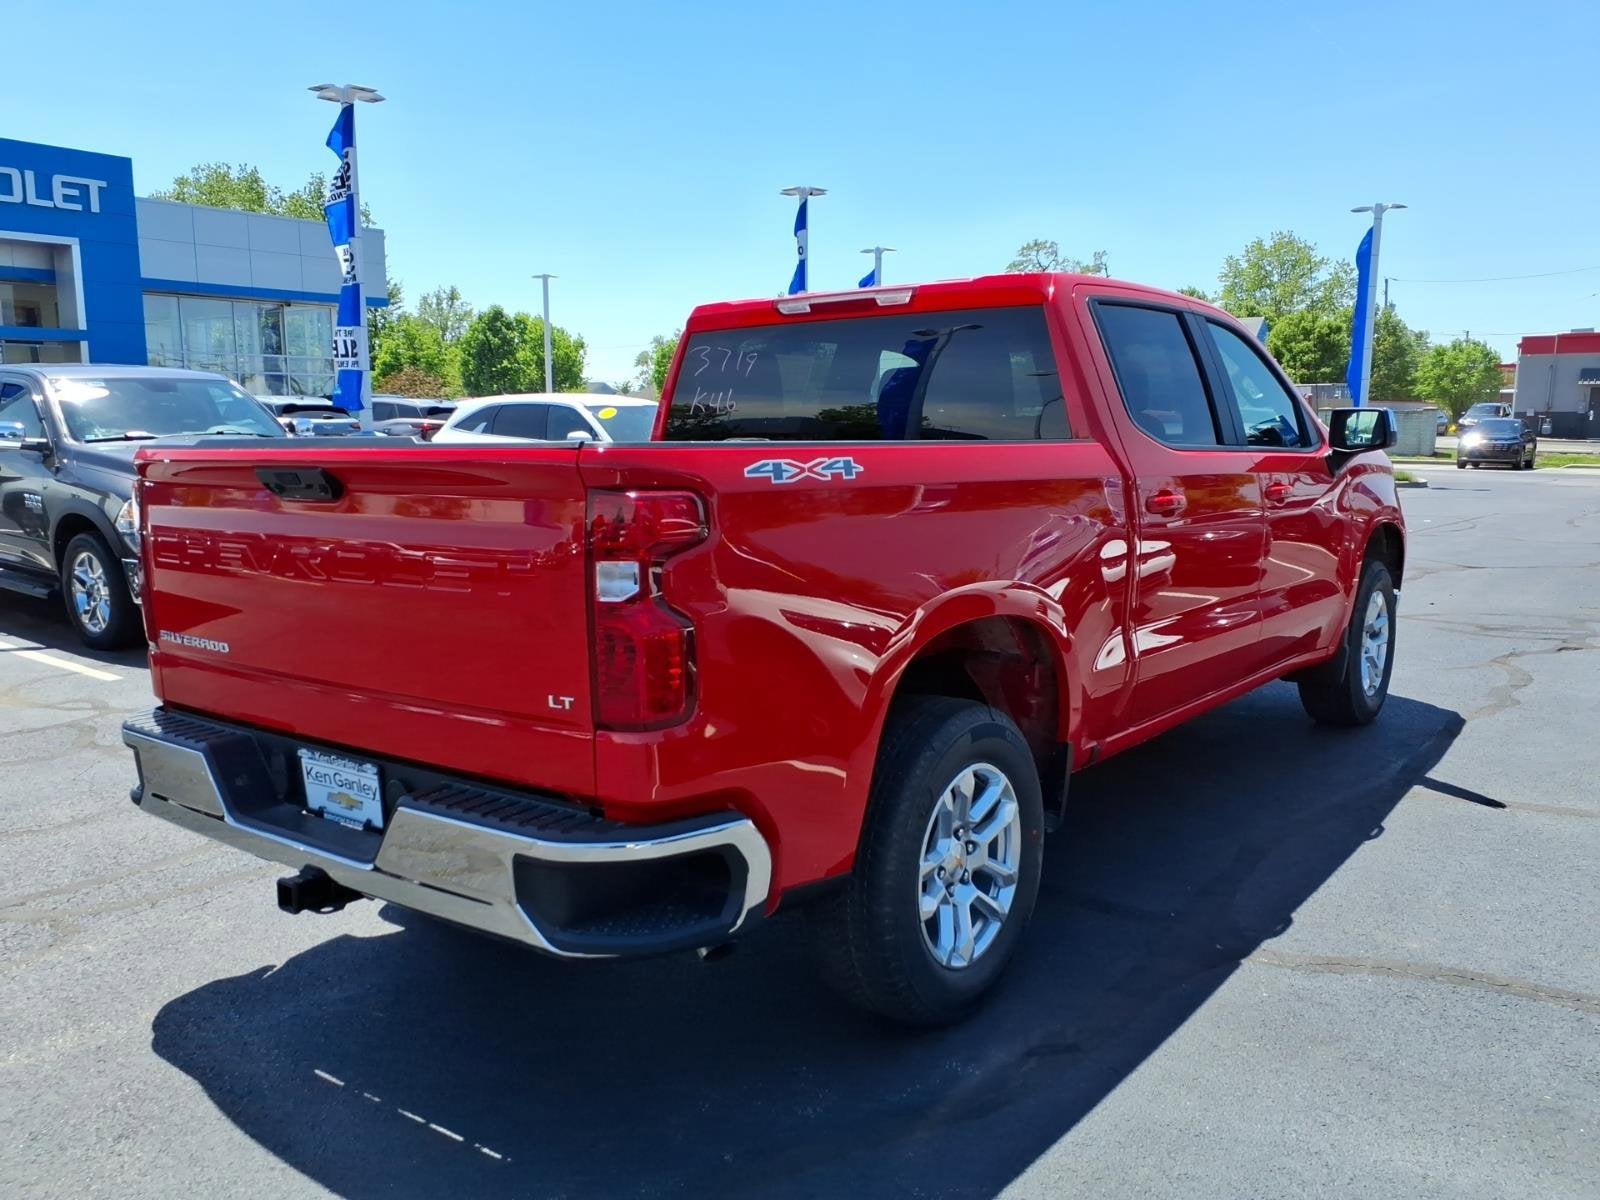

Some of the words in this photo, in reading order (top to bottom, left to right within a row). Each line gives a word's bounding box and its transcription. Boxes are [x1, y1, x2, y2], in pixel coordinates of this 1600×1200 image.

[689, 345, 758, 377] 3719
[690, 386, 736, 415] K46
[159, 629, 230, 653] SILVERADO
[548, 694, 575, 710] LT
[305, 765, 332, 785] Ken
[333, 772, 378, 801] Ganley
